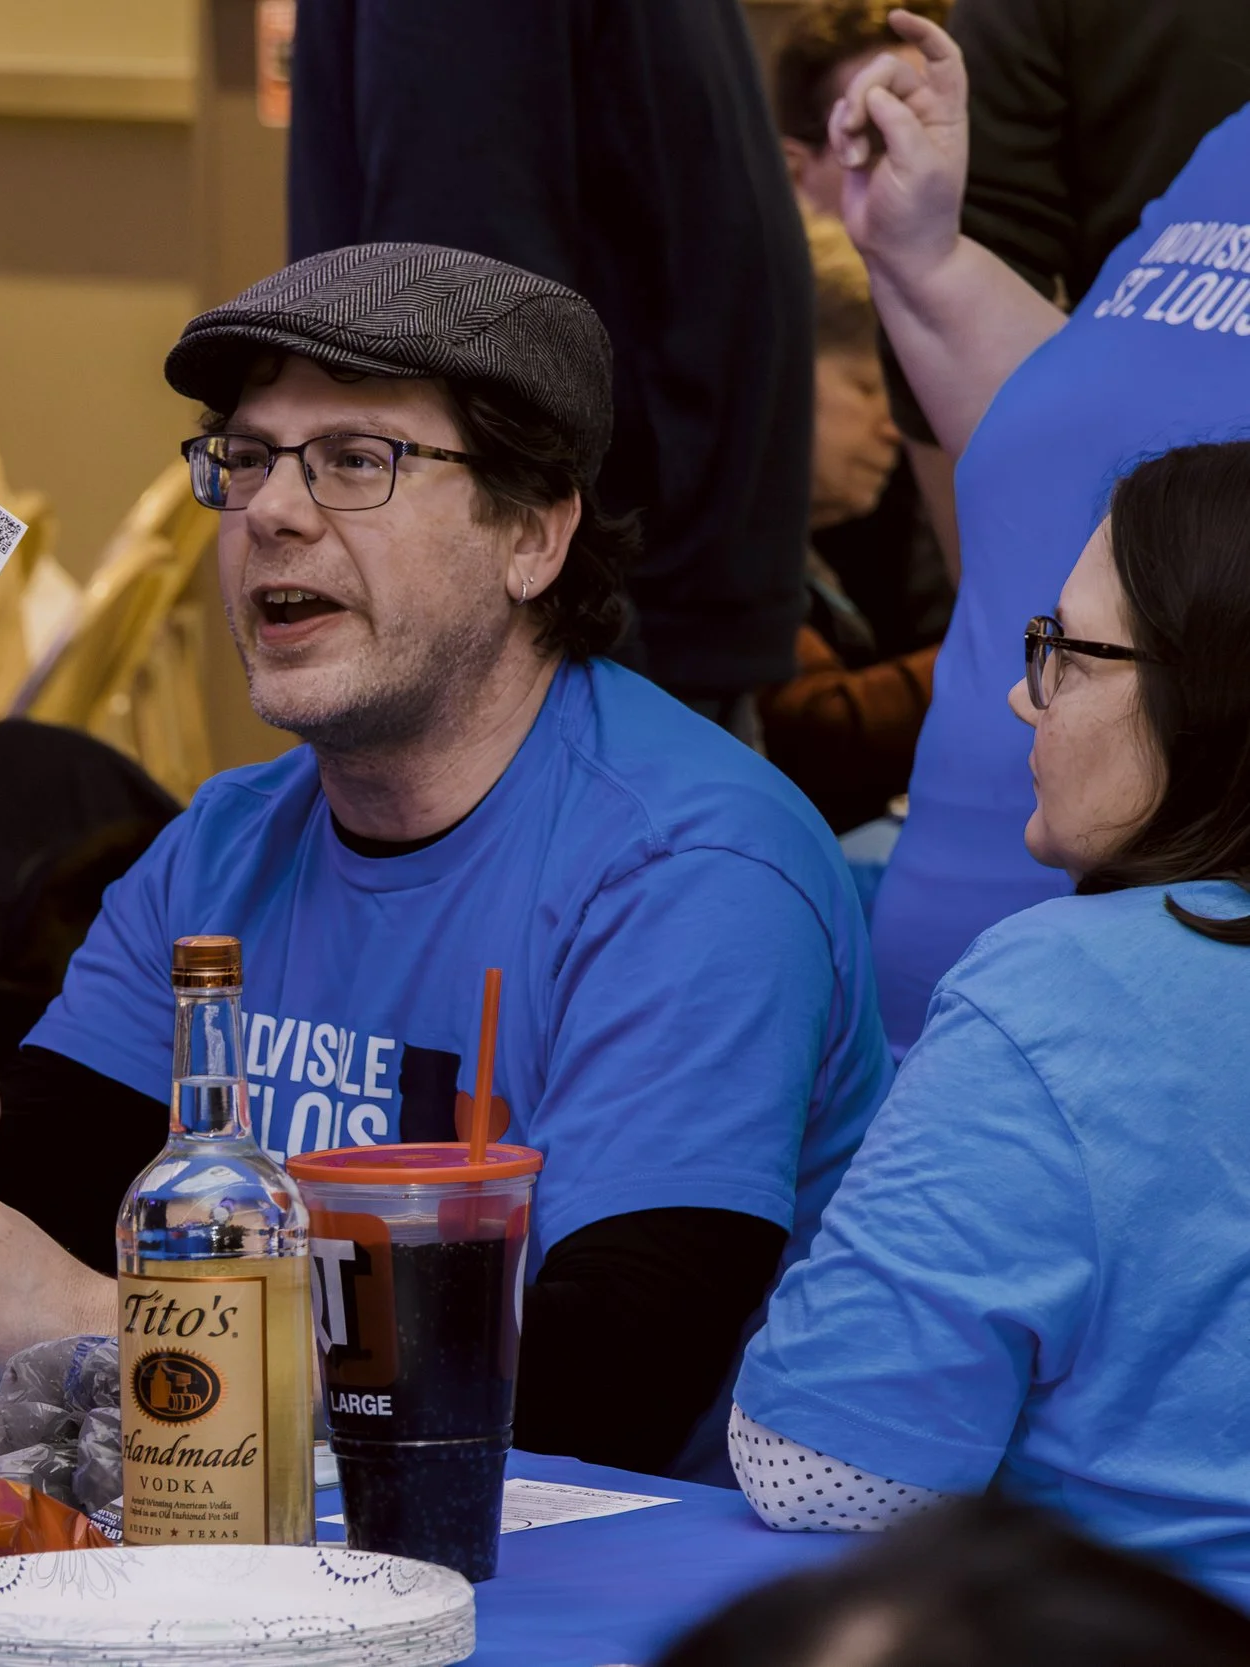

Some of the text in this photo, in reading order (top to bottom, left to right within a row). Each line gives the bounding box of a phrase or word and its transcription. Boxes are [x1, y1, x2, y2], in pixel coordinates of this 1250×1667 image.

[1093, 267, 1165, 319] ST.
[330, 1391, 393, 1416] LARGE
[123, 1429, 258, 1468] Handmade
[139, 1475, 215, 1494] VODKA
[146, 1498, 172, 1510] Winning
[173, 1500, 207, 1510] American
[209, 1500, 232, 1510] Vodka
[158, 1510, 171, 1519] Old
[172, 1511, 206, 1520] Fashioned
[208, 1512, 221, 1520] Pot
[223, 1511, 239, 1520] Still
[104, 1525, 123, 1540] LIFE
[130, 1524, 239, 1539] AUSTIN TEXAS
